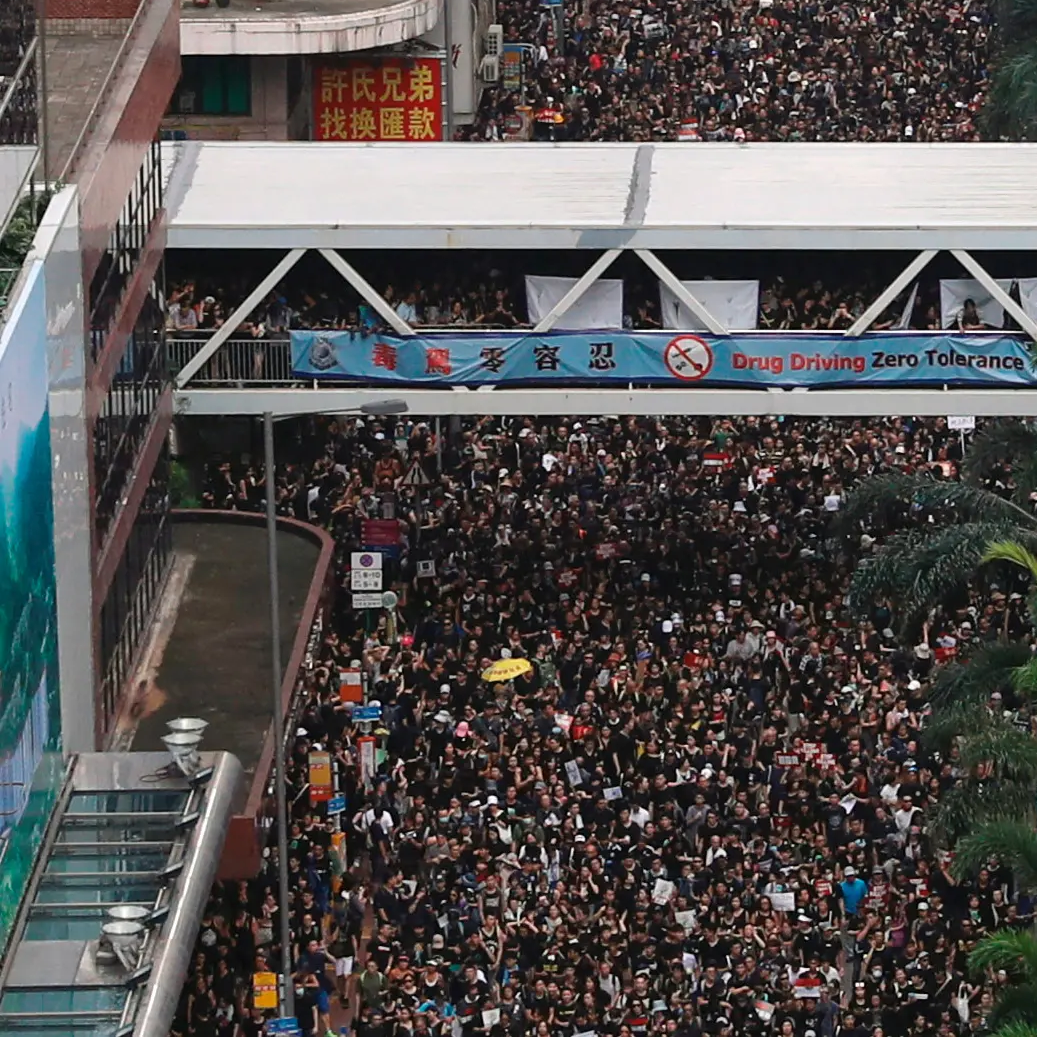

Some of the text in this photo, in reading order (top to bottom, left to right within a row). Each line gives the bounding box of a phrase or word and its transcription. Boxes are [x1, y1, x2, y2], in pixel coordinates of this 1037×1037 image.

[321, 65, 435, 103] 許氏兄弟
[320, 106, 436, 140] 找換匯款
[731, 349, 1025, 373] Drug Driving Zero Tolerance
